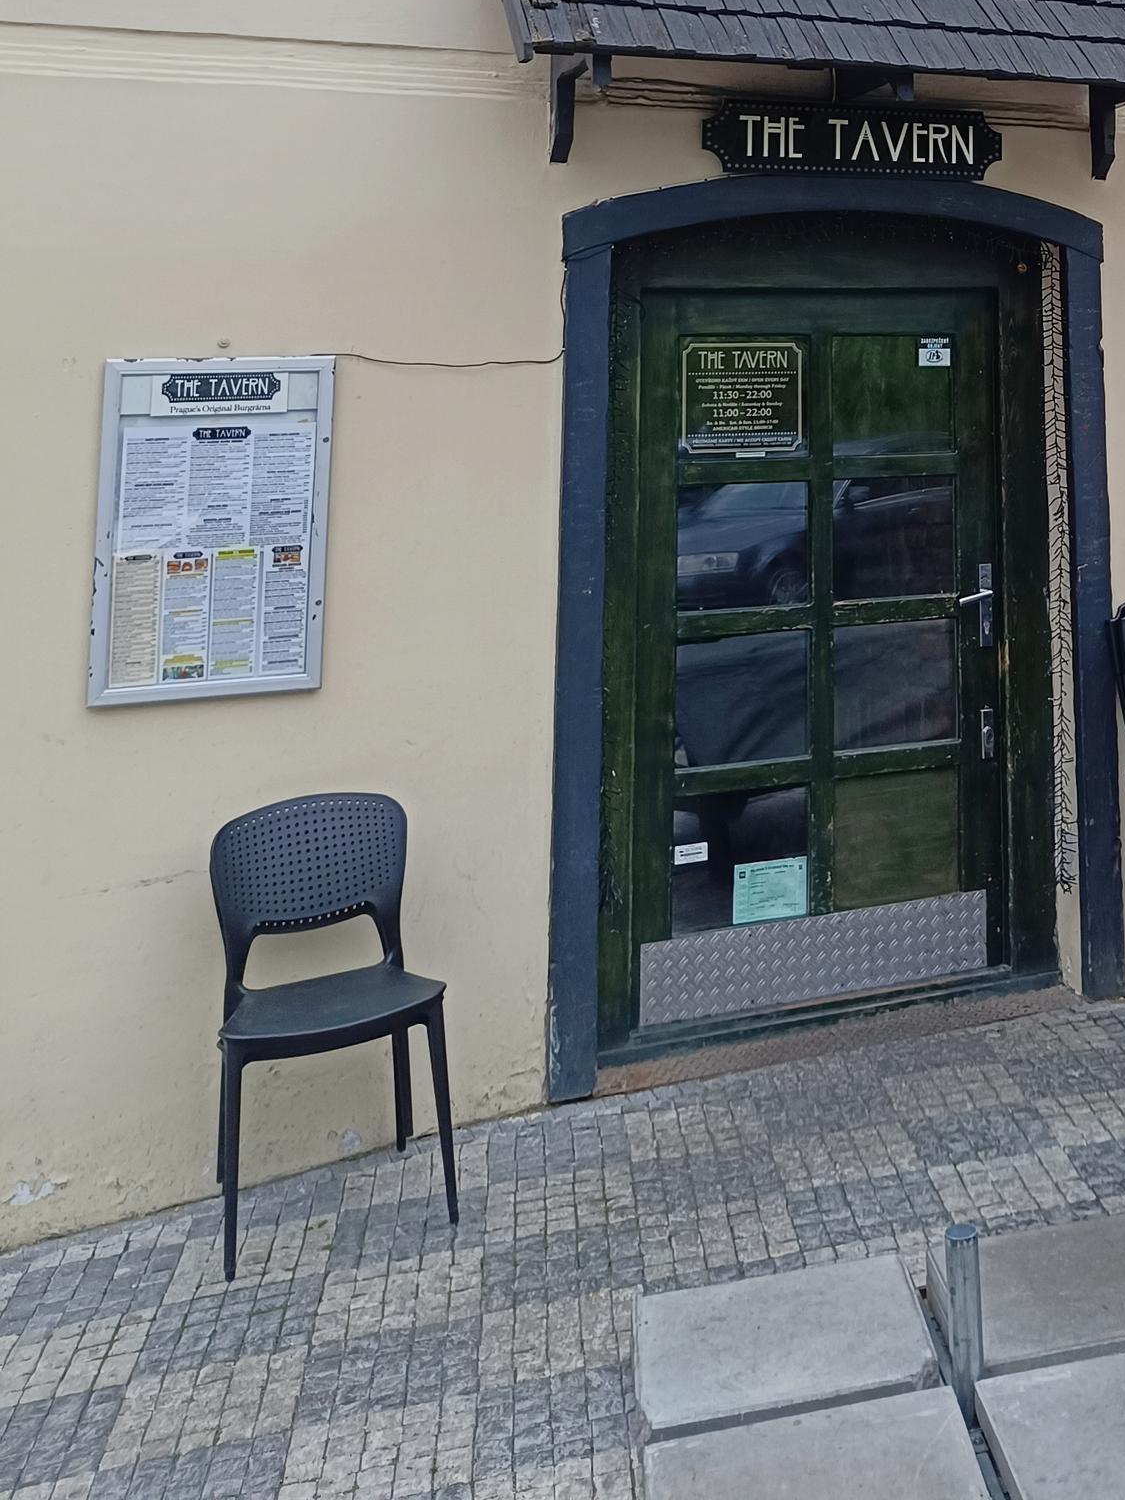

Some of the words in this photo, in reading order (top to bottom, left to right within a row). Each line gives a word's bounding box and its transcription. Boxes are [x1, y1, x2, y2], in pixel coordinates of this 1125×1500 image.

[739, 115, 805, 158] THE
[828, 119, 974, 165] TAVERN
[698, 351, 725, 369] THE
[732, 351, 787, 368] TAVERN
[176, 380, 201, 397] THE
[209, 378, 269, 396] TAVERN
[170, 406, 200, 414] Prague's
[200, 430, 211, 438] THE
[216, 429, 245, 437] TAVERN
